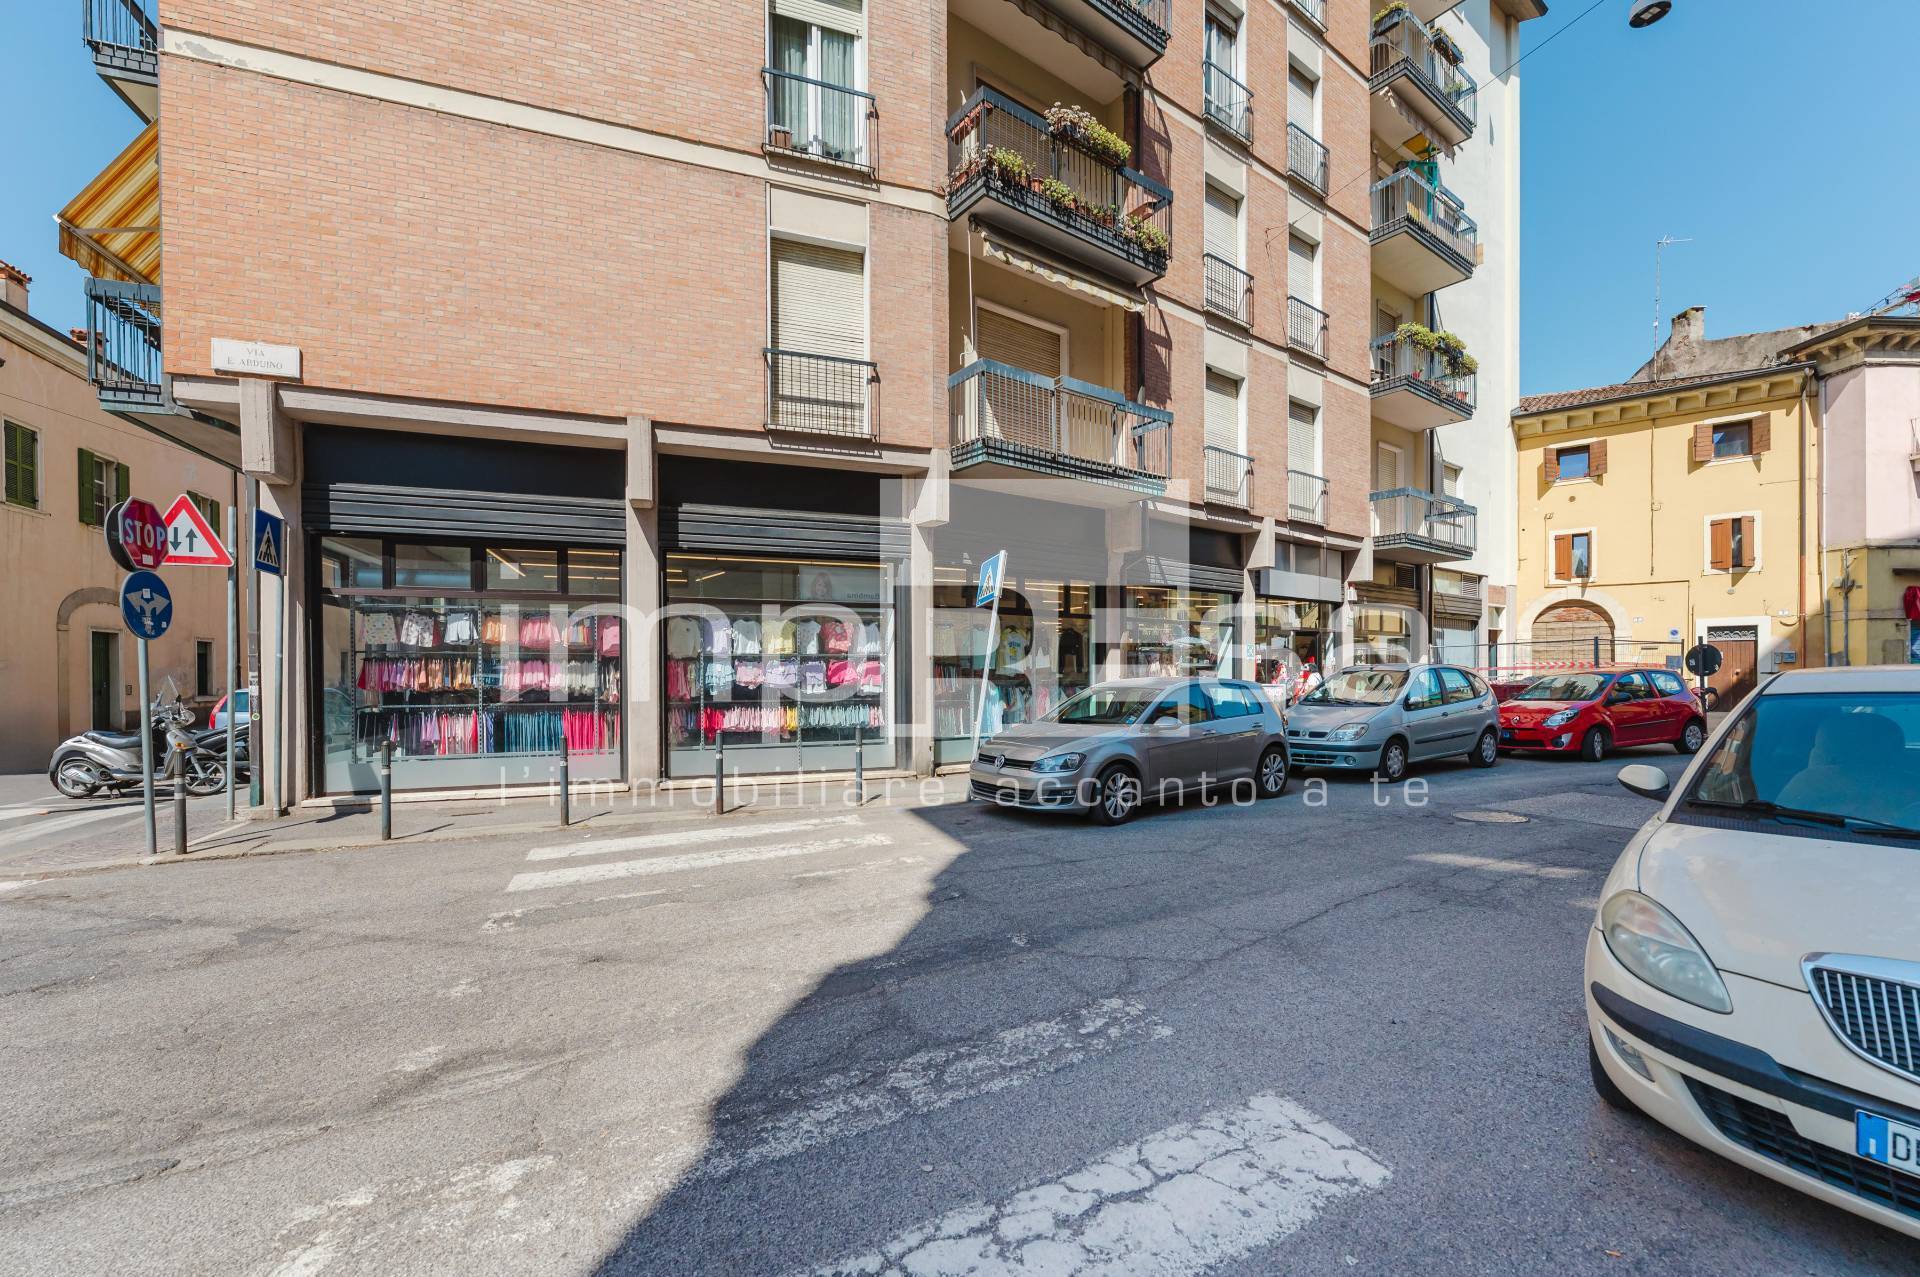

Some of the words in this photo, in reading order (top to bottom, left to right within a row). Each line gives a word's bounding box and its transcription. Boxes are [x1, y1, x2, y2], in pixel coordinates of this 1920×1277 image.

[245, 347, 265, 357] VIA
[239, 358, 284, 370] ARDUINO
[124, 518, 166, 551] STOP
